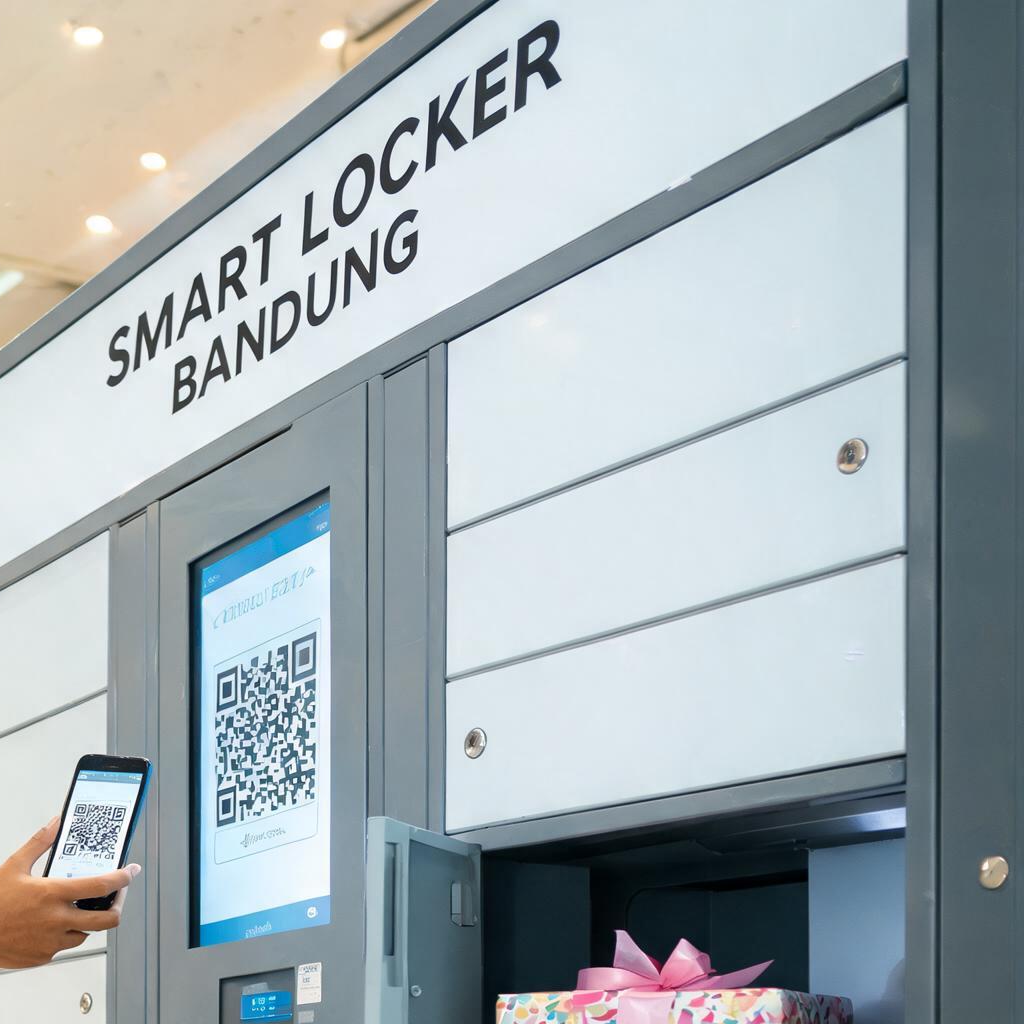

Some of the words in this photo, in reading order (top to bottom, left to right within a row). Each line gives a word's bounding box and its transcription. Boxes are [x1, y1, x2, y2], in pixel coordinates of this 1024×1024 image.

[106, 213, 282, 387] SMART
[301, 19, 562, 257] LOCKER
[171, 209, 419, 415] BANDUNG
